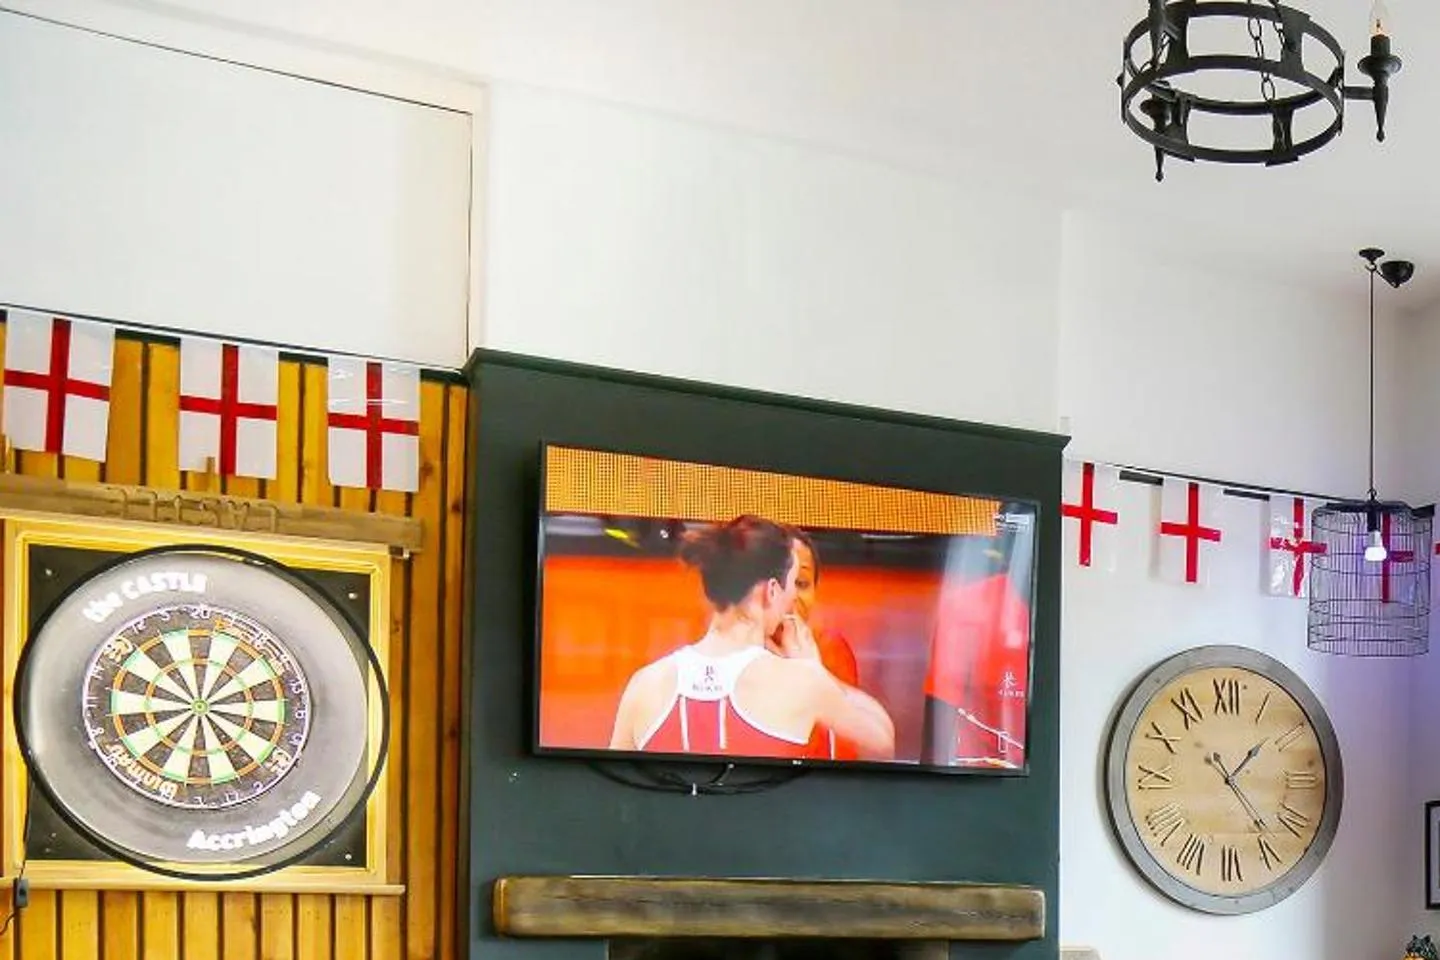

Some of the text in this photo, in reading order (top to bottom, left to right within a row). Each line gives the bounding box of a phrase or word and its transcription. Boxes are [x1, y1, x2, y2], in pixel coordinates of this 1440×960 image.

[121, 572, 208, 600] CASTLE
[1212, 677, 1241, 716] XII
[186, 790, 322, 850] Accrington
